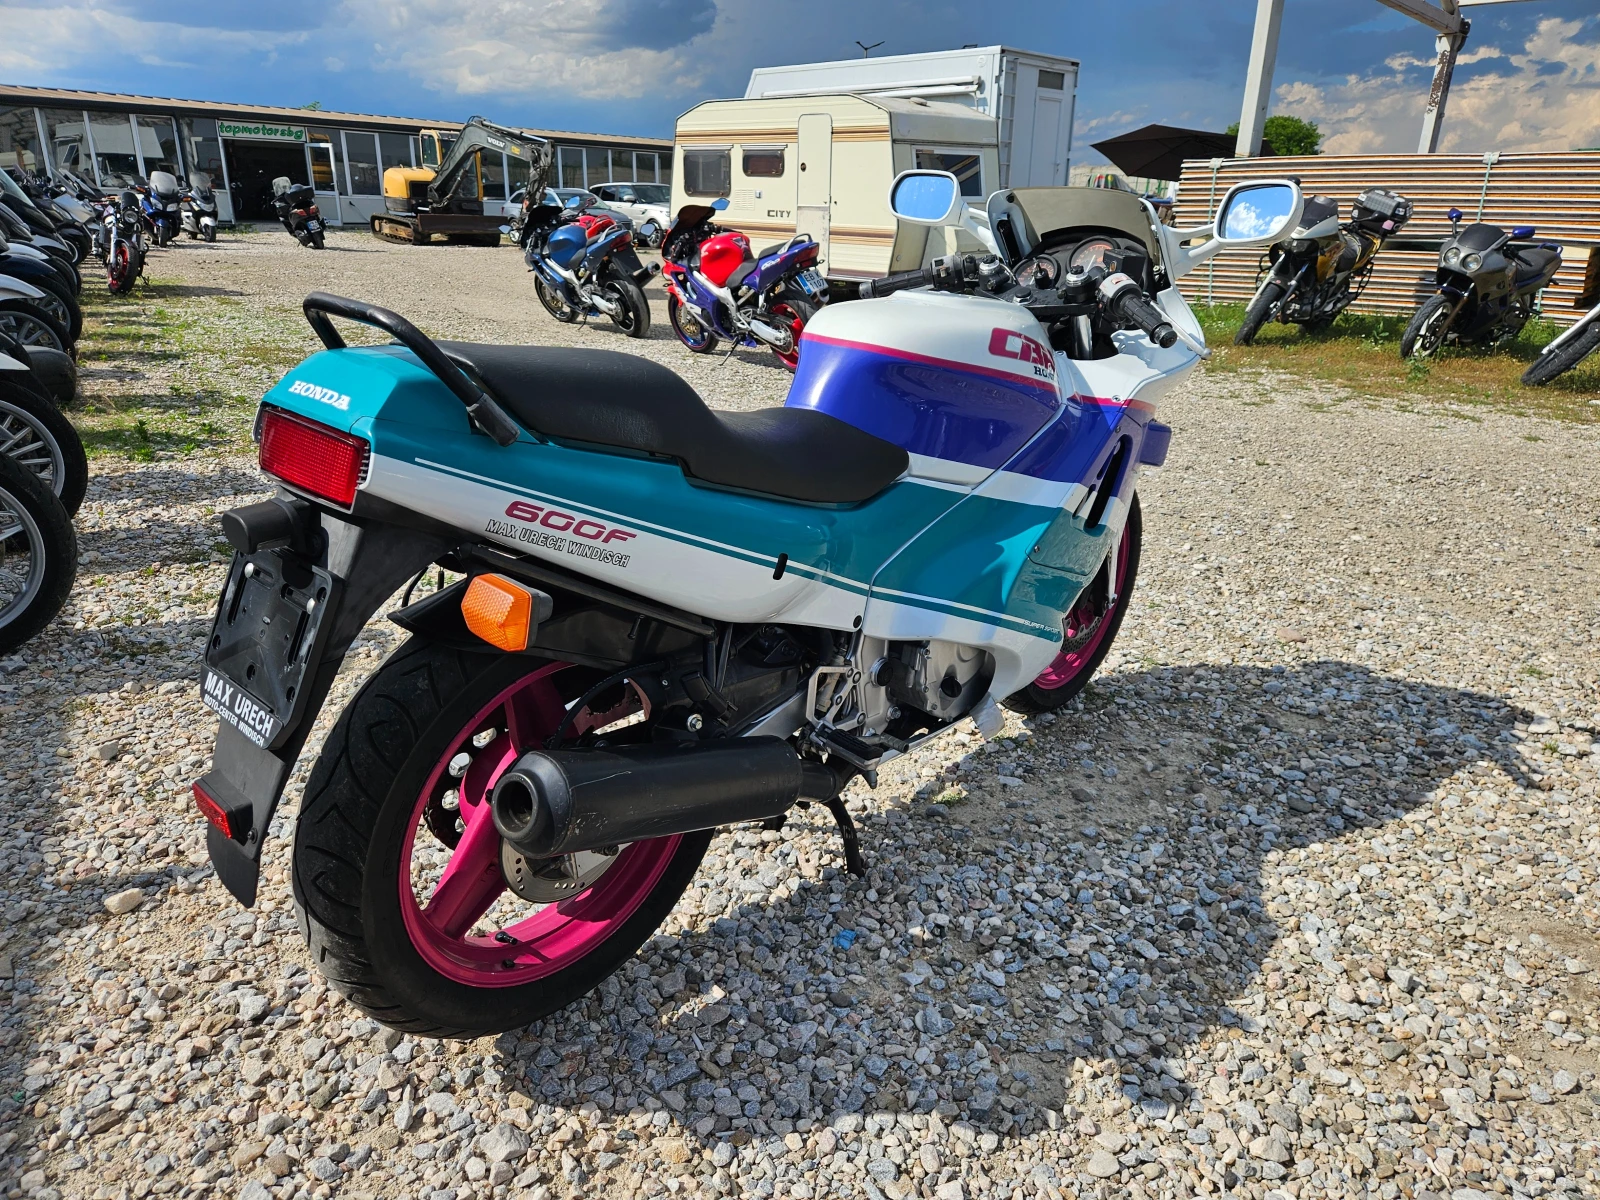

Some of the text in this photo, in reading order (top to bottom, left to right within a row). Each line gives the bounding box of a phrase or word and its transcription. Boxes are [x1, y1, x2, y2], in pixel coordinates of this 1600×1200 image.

[219, 121, 304, 140] topmotorsbg
[767, 209, 791, 218] CITY
[288, 380, 351, 411] HONDA
[485, 519, 631, 568] MAX URECH WINDISCH
[504, 500, 637, 544] 600F
[203, 693, 265, 747] MOTO-CENTER WINDISCH
[204, 671, 274, 738] MAX URECH
